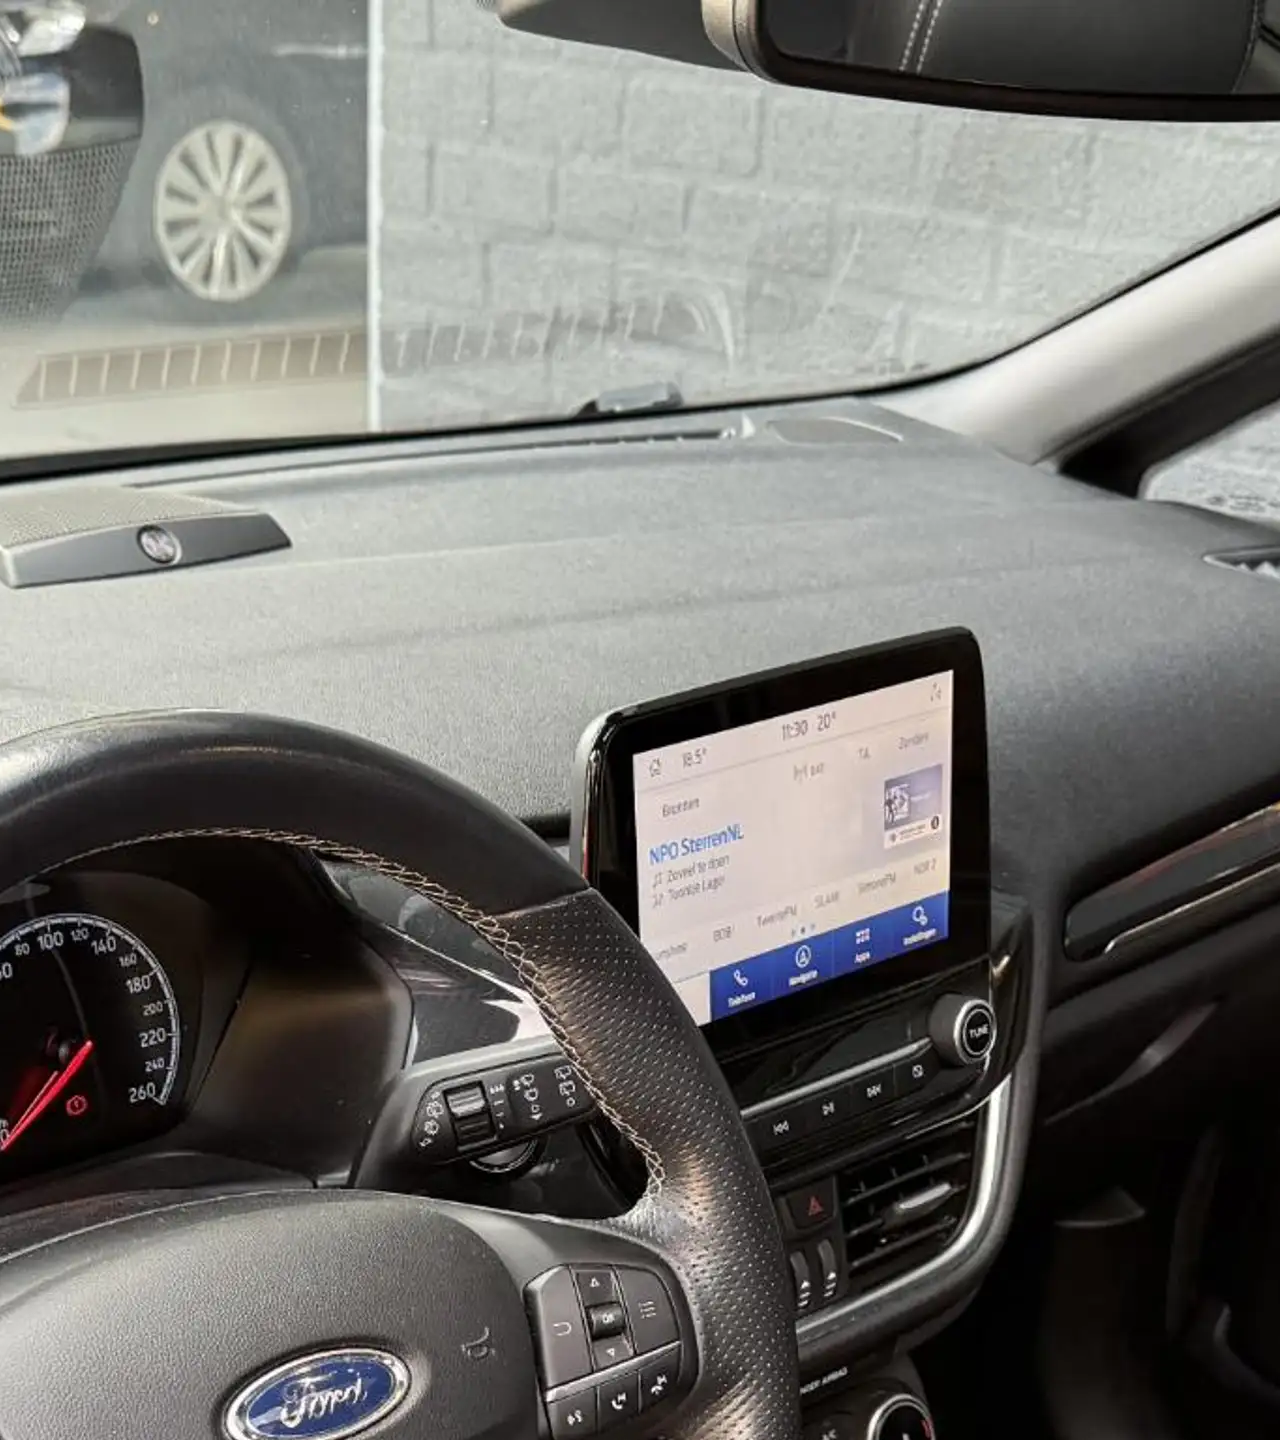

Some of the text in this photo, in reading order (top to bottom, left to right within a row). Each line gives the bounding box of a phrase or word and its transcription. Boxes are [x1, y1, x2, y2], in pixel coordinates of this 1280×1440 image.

[782, 720, 808, 741] 11:30
[649, 824, 745, 866] NPO SterrenNL
[37, 931, 64, 950] 100
[71, 928, 89, 942] 120
[15, 943, 30, 956] 80
[91, 935, 117, 956] 140
[119, 953, 138, 968] 160
[126, 974, 151, 994] 180
[143, 1001, 163, 1016] 200
[139, 1027, 166, 1048] 220
[969, 1023, 989, 1039] TUNE
[145, 1057, 165, 1072] 240
[129, 1082, 156, 1103] 260
[280, 1370, 368, 1428] Ford
